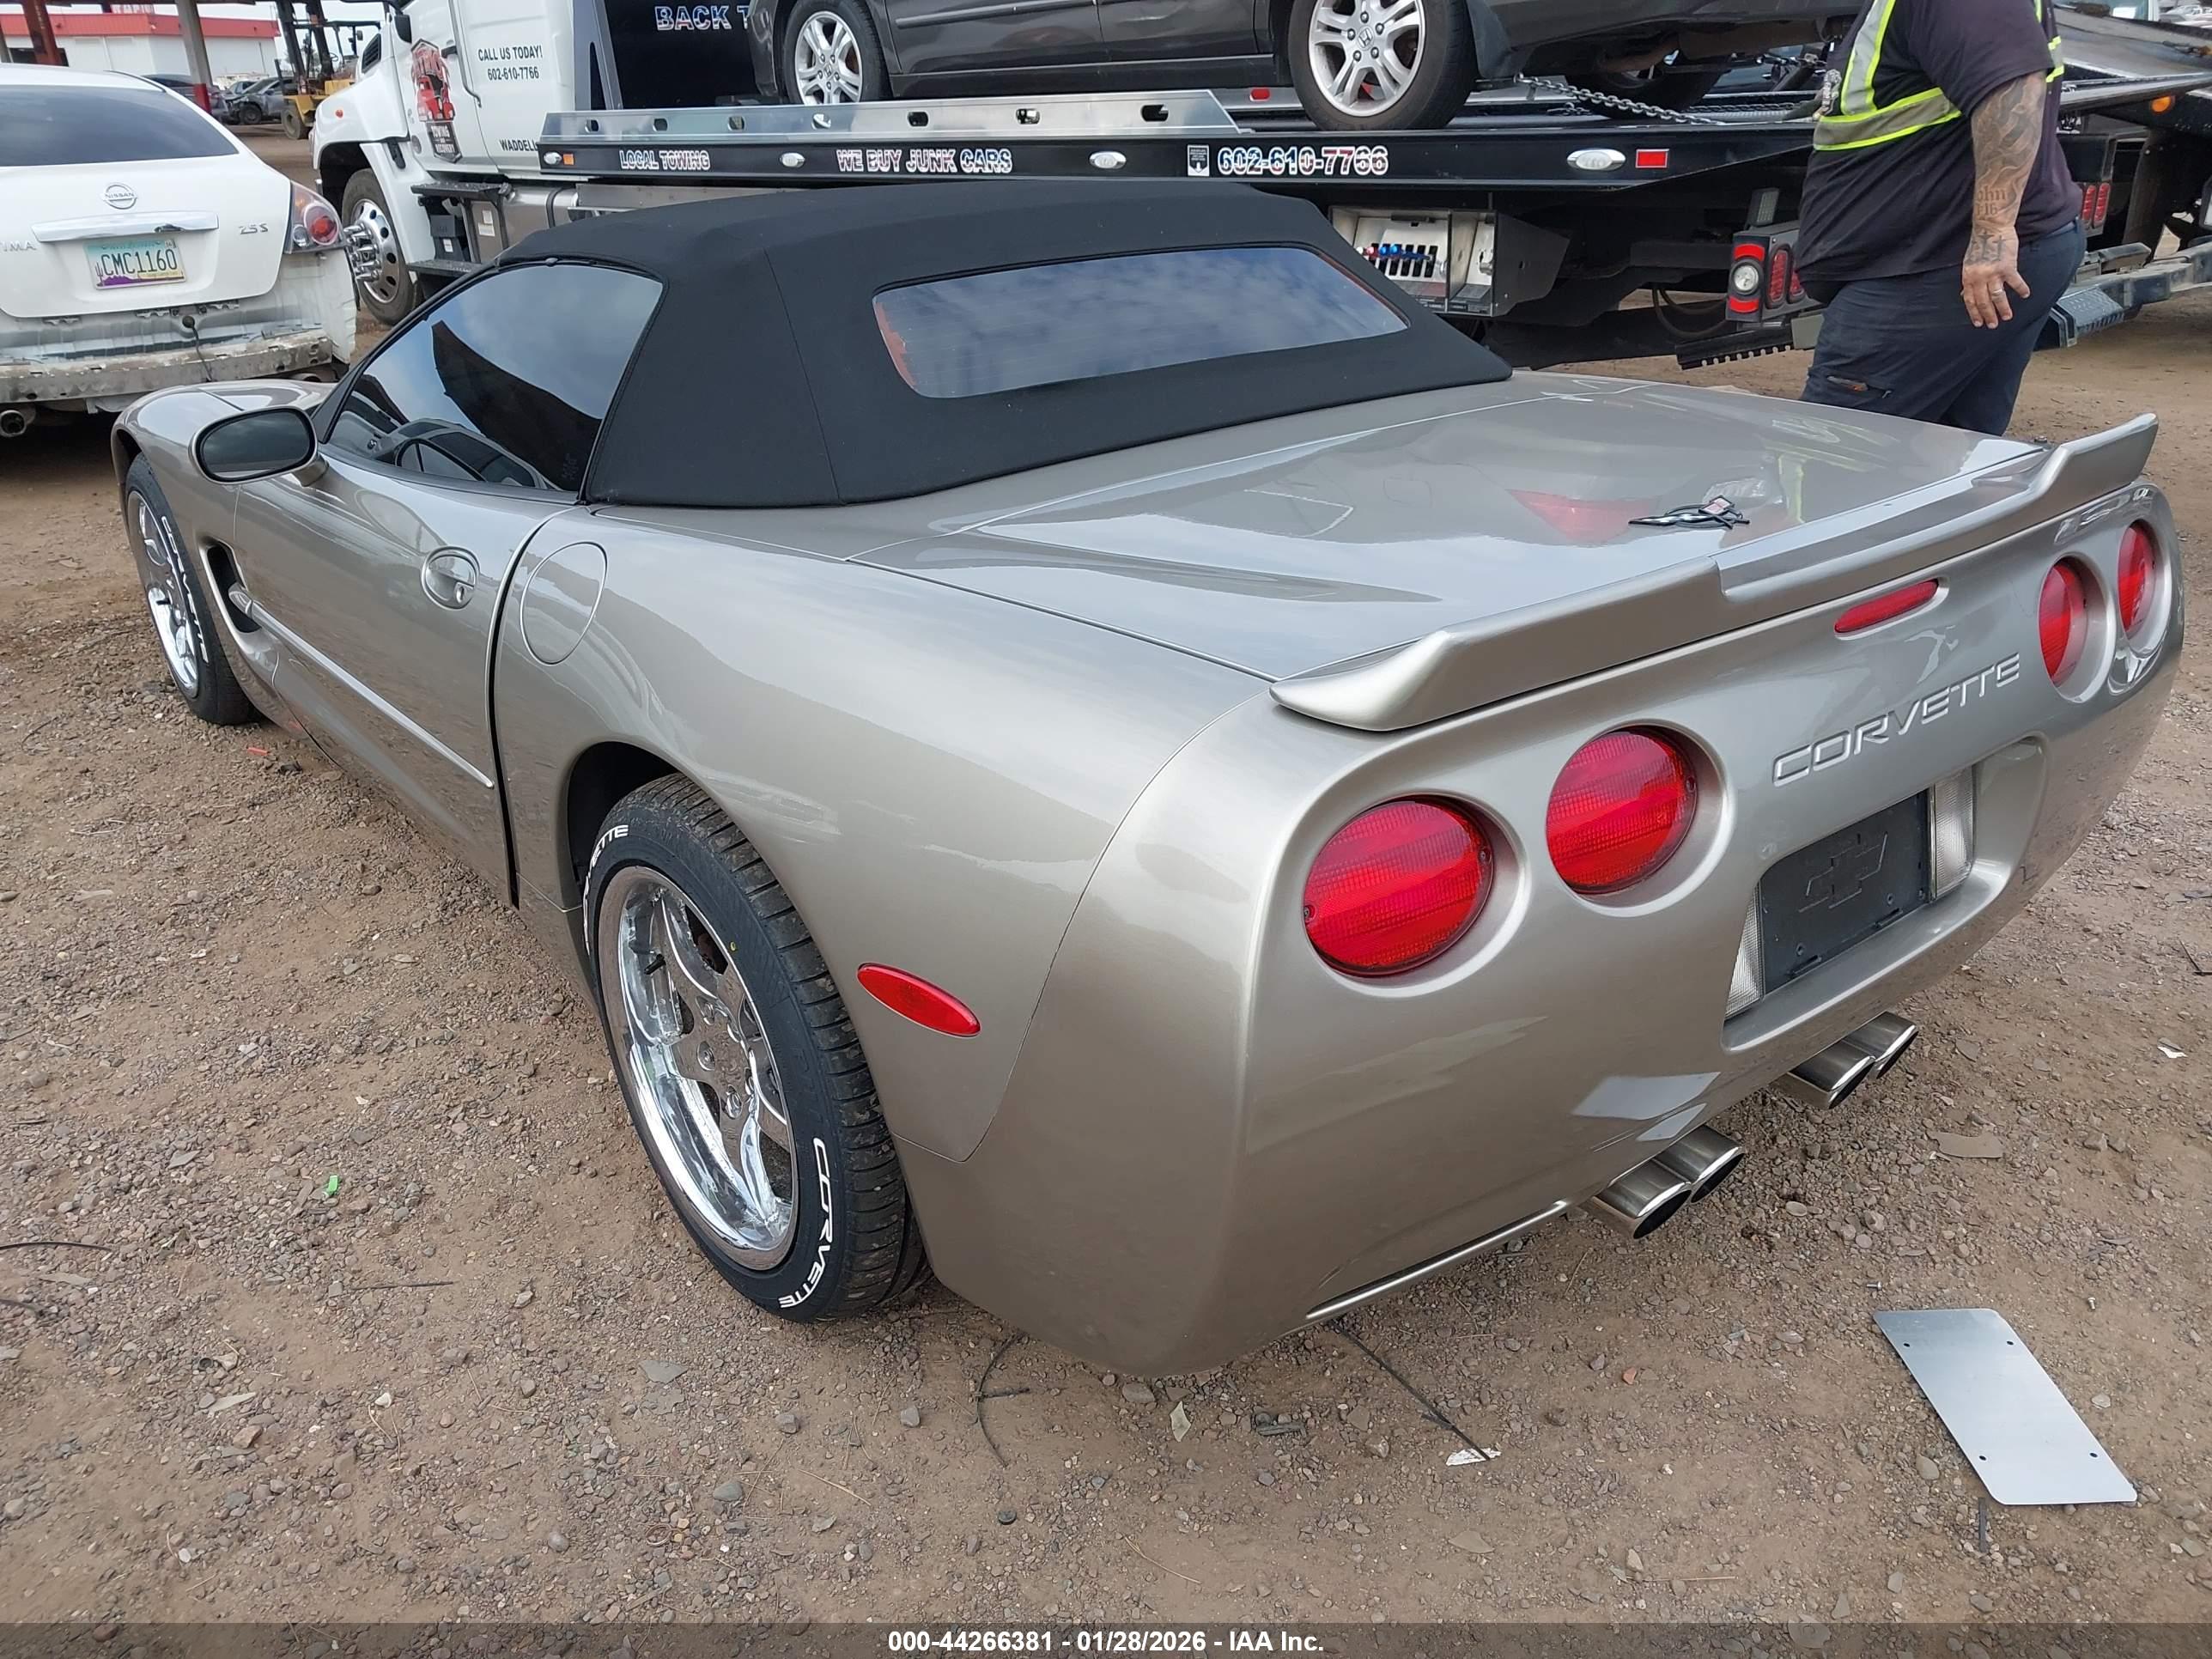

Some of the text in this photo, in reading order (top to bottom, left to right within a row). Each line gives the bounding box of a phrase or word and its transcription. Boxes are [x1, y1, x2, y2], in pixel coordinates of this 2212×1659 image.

[654, 5, 750, 30] BACK T
[477, 45, 544, 61] CALL US TODAY!
[487, 66, 539, 81] 602-610-7766
[619, 150, 711, 171] LOCAL TOWING
[836, 149, 1012, 173] WE BUY JUNK CARS
[1218, 145, 1389, 175] 602-610-7766
[1978, 185, 2007, 202] ohn
[0, 240, 38, 252] IMA
[101, 248, 179, 276] CMC1160
[1771, 652, 2021, 787] CORVETTE
[778, 1136, 834, 1310] CORVETTE
